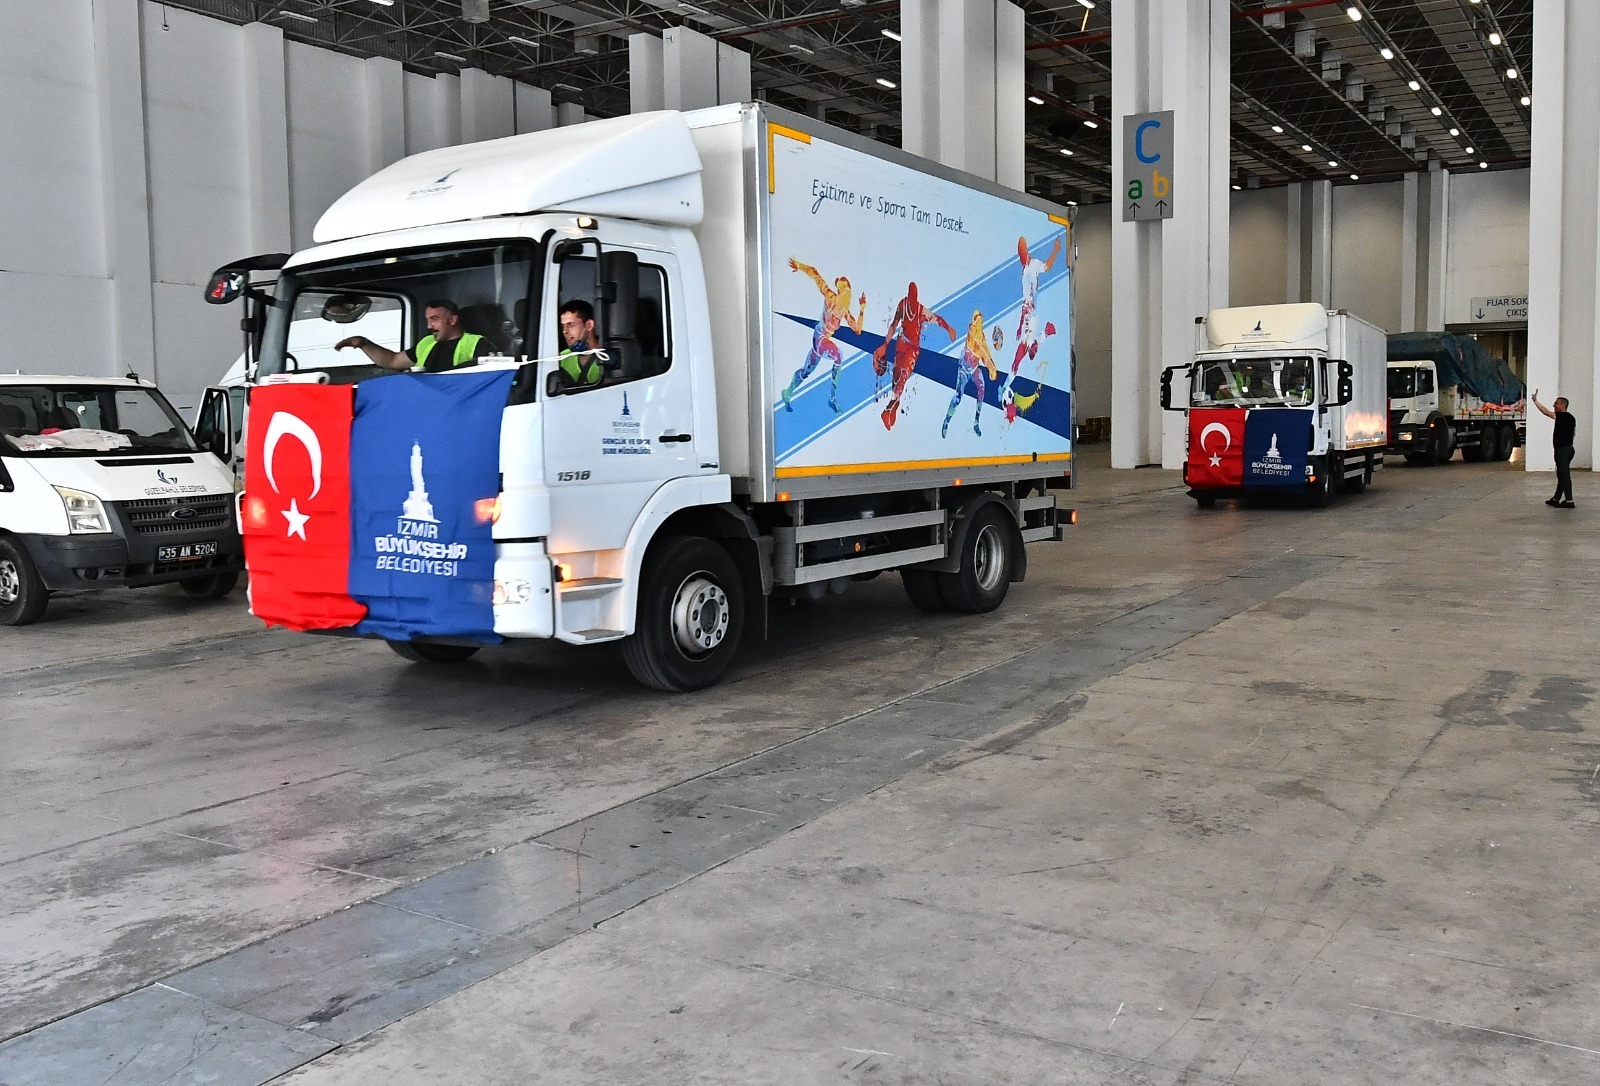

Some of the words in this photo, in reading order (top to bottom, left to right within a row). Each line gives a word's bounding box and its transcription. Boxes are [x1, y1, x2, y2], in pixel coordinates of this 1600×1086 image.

[1135, 120, 1161, 164] C
[1127, 179, 1143, 200] a
[1153, 169, 1169, 198] b
[811, 179, 855, 215] Eğitime
[859, 194, 872, 210] ve
[876, 196, 906, 219] Spora
[910, 204, 931, 225] Tam
[1486, 298, 1510, 307] FUAR
[1506, 308, 1527, 318] ÇIKIŞ
[602, 437, 626, 446] GENÇLİK
[557, 470, 591, 482] 1518
[397, 519, 439, 540] İZMİR
[165, 547, 177, 559] 35
[180, 546, 191, 557] AN
[195, 543, 215, 555] 5204
[374, 534, 468, 560] BÜYÜKŞEHİR
[375, 555, 458, 577] BELEDİYESİ
